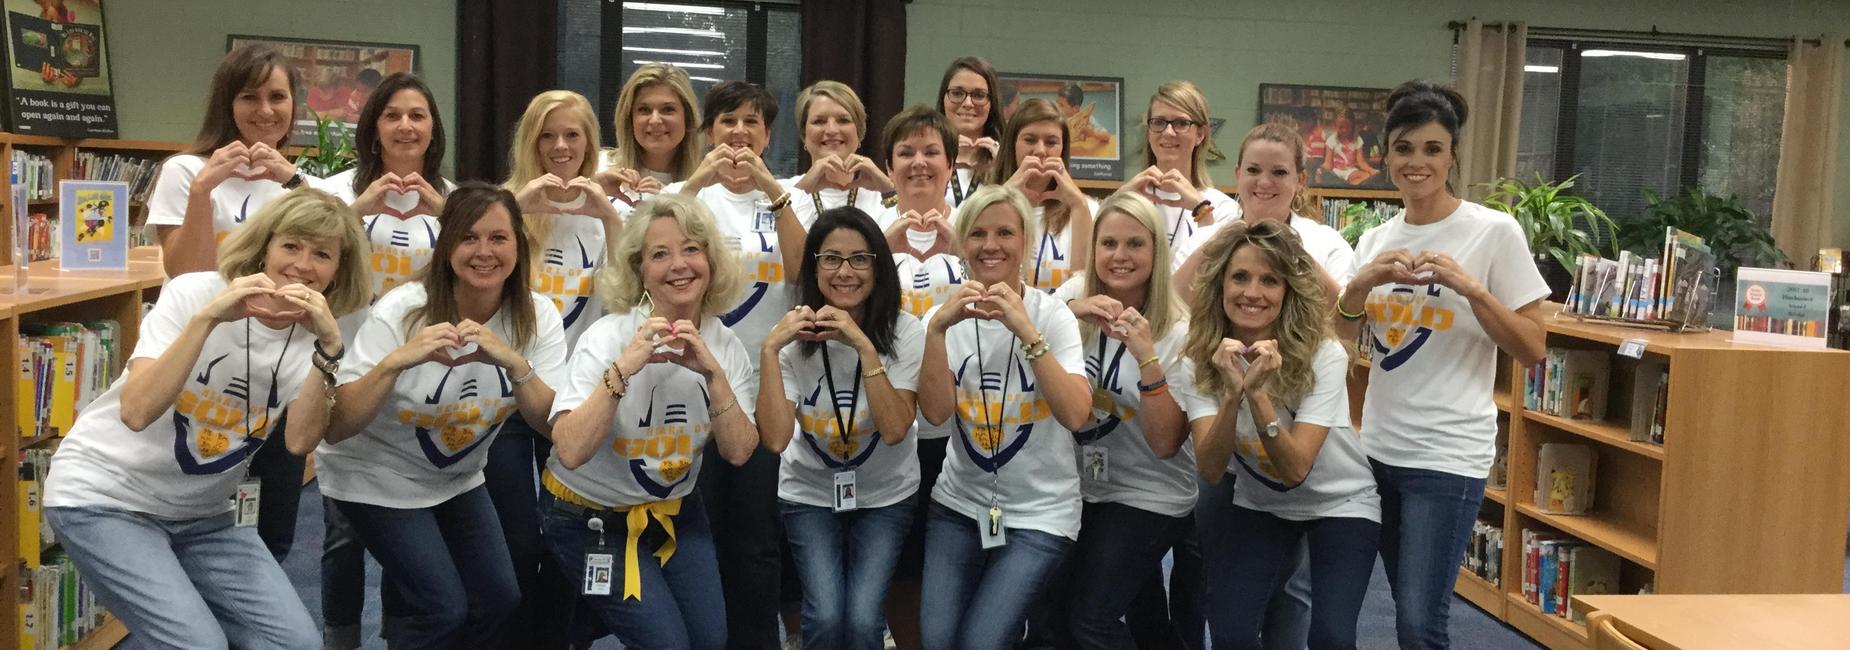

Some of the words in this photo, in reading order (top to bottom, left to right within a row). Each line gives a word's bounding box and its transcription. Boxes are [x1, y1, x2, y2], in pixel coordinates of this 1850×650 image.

[30, 98, 49, 107] book
[51, 99, 58, 108] is
[66, 101, 79, 111] gift
[81, 103, 96, 111] you
[21, 111, 41, 120] open
[43, 112, 64, 121] again
[66, 113, 80, 121] and
[1081, 162, 1112, 171] something
[530, 271, 594, 295] OLD
[22, 358, 30, 373] 1.4
[65, 362, 73, 376] 1.5
[957, 400, 1052, 424] OLD
[612, 434, 703, 458] GOL
[28, 491, 37, 506] 1.6
[25, 614, 34, 628] 1.7
